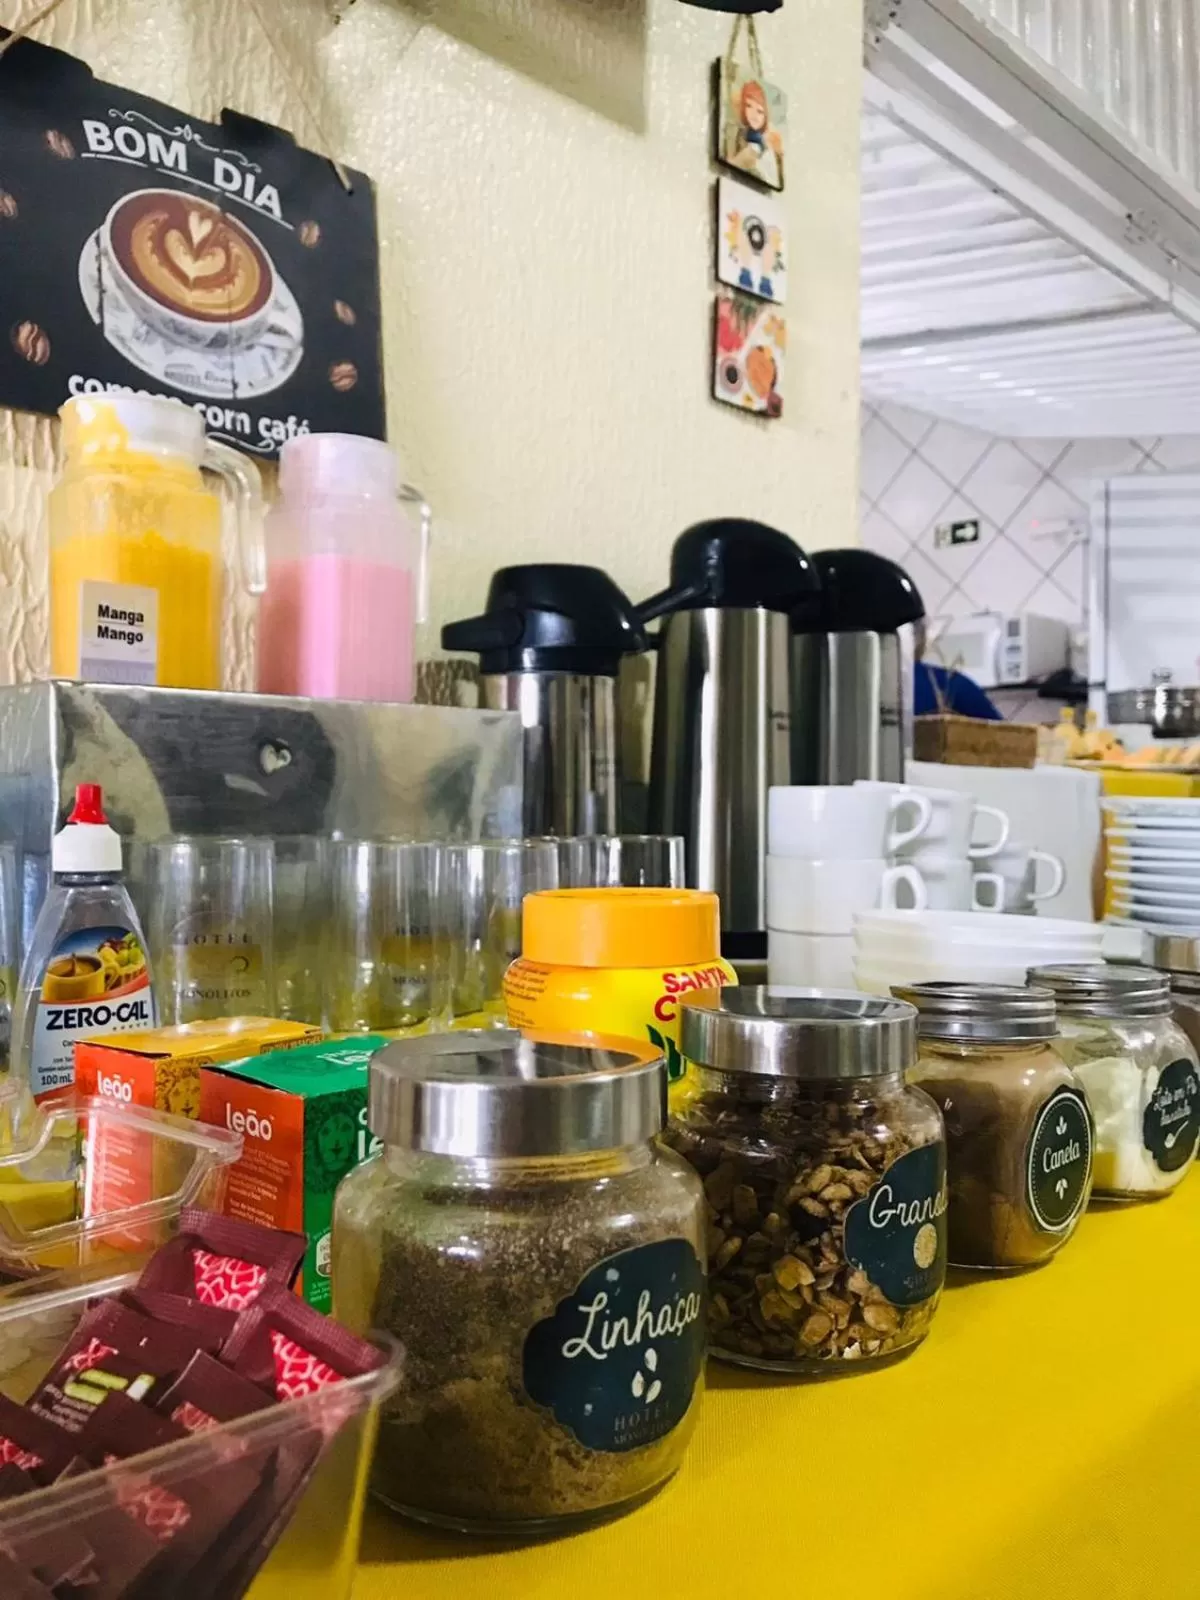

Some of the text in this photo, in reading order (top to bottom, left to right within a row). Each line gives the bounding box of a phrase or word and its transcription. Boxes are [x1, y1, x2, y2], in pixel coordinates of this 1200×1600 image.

[82, 119, 283, 220] BOM DIA
[97, 604, 144, 625] Manga
[97, 625, 144, 645] Mango
[661, 966, 729, 993] SANTA
[41, 1075, 58, 1086] 100
[97, 1069, 132, 1103] leão
[226, 1102, 272, 1141] leão
[1043, 1139, 1080, 1173] Canela
[562, 1289, 701, 1360] Linhaça
